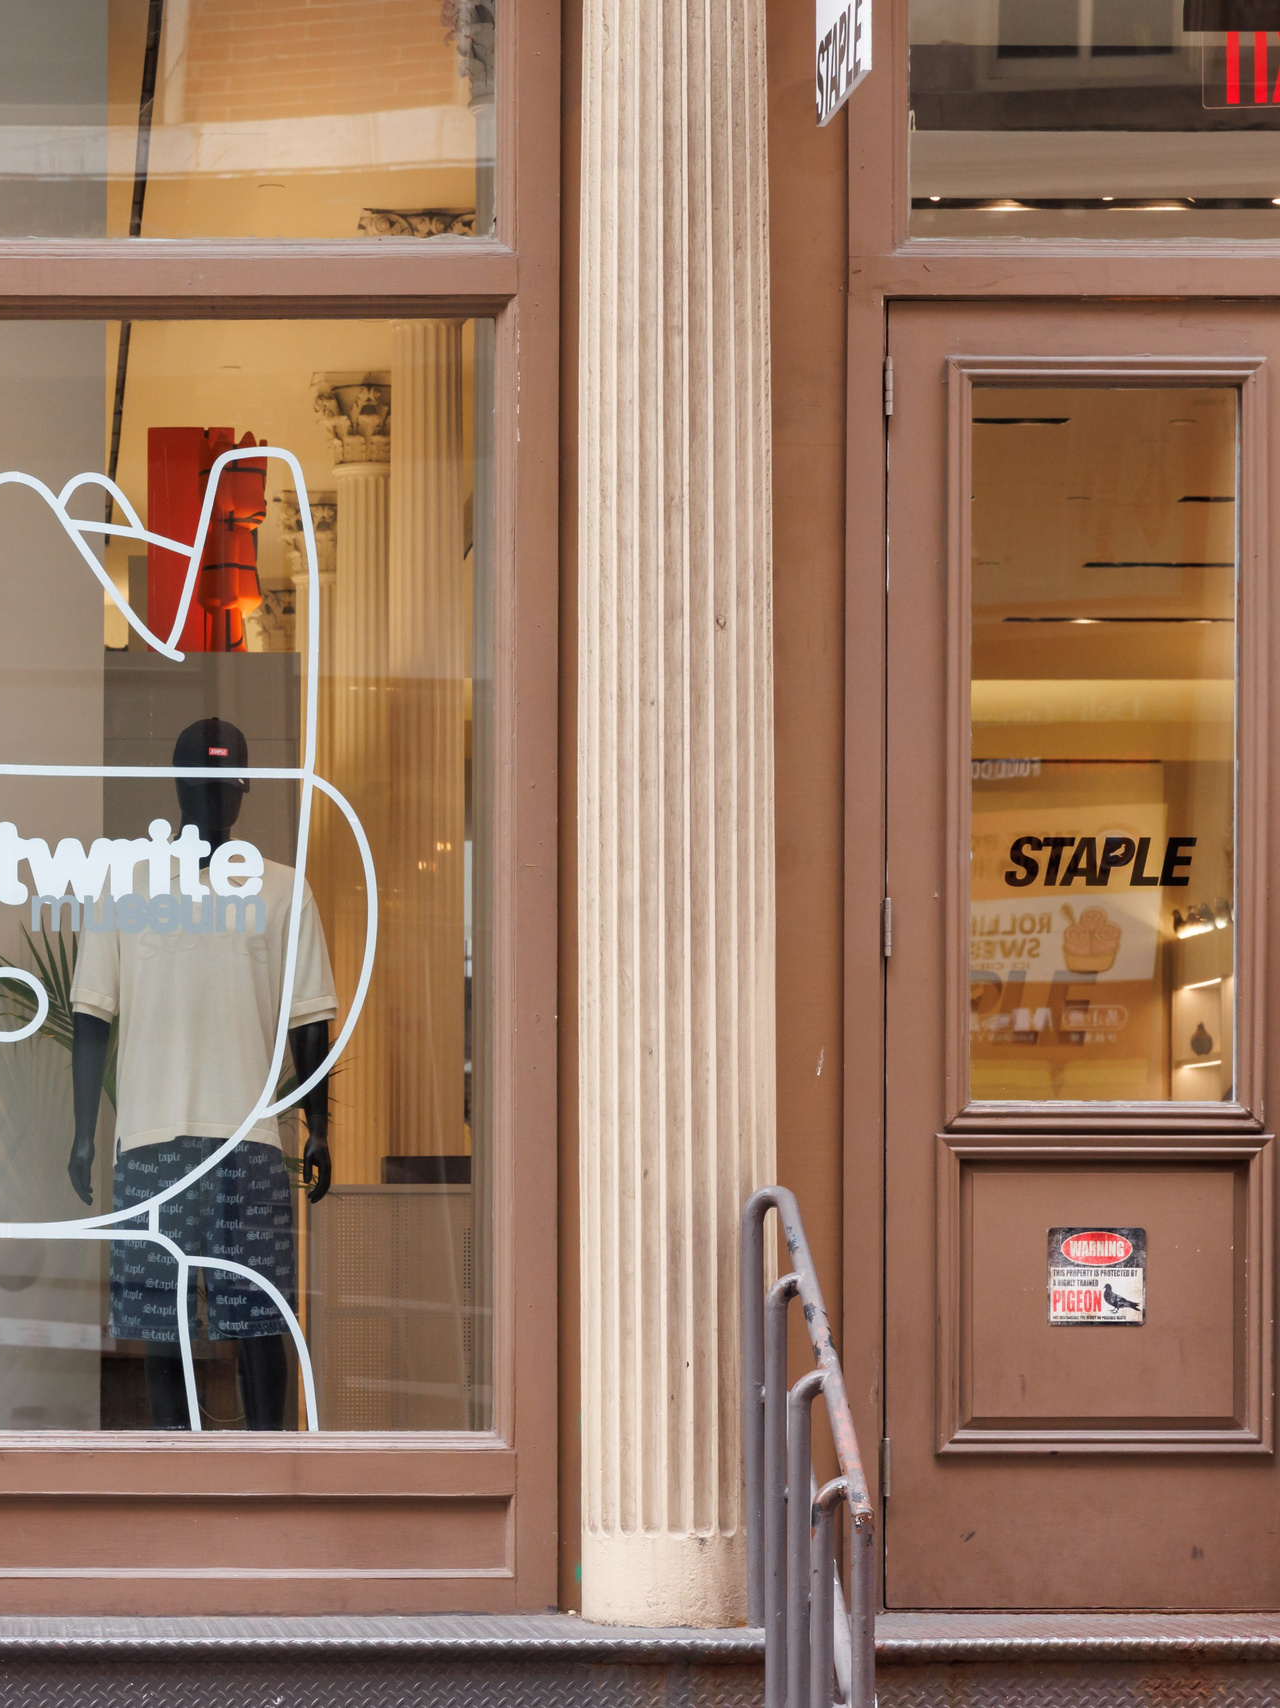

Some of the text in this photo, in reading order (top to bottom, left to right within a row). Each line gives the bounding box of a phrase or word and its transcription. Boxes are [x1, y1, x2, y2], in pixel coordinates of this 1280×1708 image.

[816, 0, 862, 125] STAPLE
[1004, 836, 1197, 887] STAPLE
[31, 893, 266, 933] museum
[127, 1159, 159, 1174] Staple
[215, 1167, 247, 1180] Staple
[213, 1243, 245, 1256] Staple
[1069, 1240, 1125, 1257] WARNING
[1053, 1269, 1138, 1277] THIS PROPERTY IS PROTECTED BY
[215, 1294, 247, 1307] Staple
[1052, 1290, 1102, 1312] PIGEON
[143, 1303, 176, 1317] Staple
[218, 1319, 249, 1332] Staple
[141, 1328, 176, 1342] Staple
